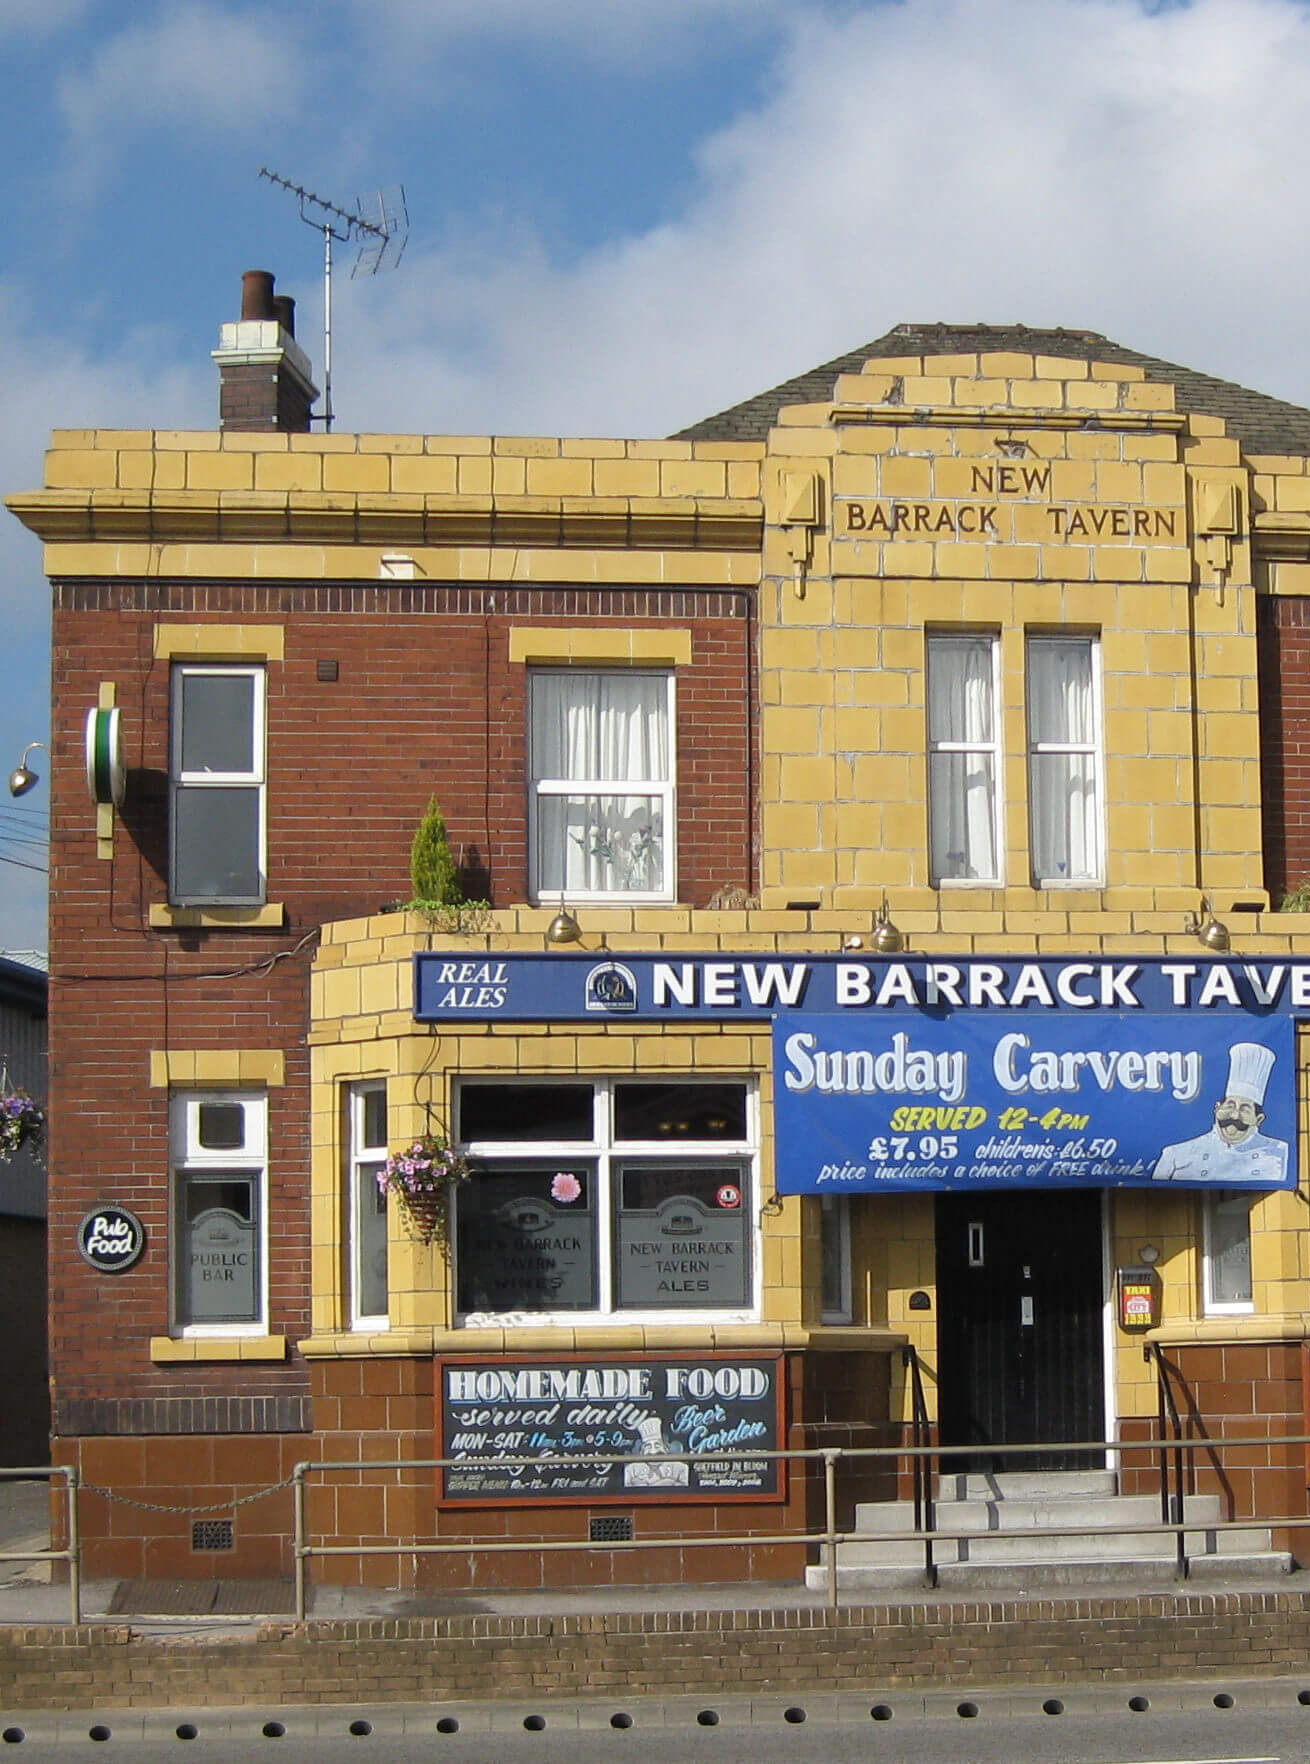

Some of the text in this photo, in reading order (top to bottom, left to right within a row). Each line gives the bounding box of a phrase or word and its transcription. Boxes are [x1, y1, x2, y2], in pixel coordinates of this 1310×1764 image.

[971, 466, 1050, 493] NEW
[846, 503, 1176, 537] BARRACK TAVERN
[438, 963, 508, 984] REAL
[653, 964, 807, 1005] NEW
[837, 964, 1138, 1006] BARRACK
[438, 987, 507, 1008] ALES
[784, 1032, 1201, 1102] Sunday Carvery
[890, 1107, 987, 1131] SERVED
[868, 1136, 958, 1160] £7.95
[816, 1160, 866, 1184] price
[874, 1161, 947, 1178] includes
[954, 1166, 966, 1178] a
[969, 1160, 1023, 1178] choice
[1026, 1161, 1048, 1177] of
[1049, 1162, 1089, 1177] FREE
[93, 1217, 129, 1236] Pub
[87, 1231, 133, 1255] Food
[514, 1237, 582, 1250] BARRACK
[630, 1242, 735, 1255] NEW BARRACK
[191, 1253, 248, 1267] PUBLIC
[501, 1259, 556, 1270] TAVERN
[655, 1261, 710, 1273] TAVERN
[202, 1268, 235, 1282] BAR
[656, 1280, 710, 1292] ALES
[448, 1367, 769, 1402] HOMEMADE FOOD
[452, 1402, 652, 1430] served daily
[671, 1404, 726, 1432] Beer
[689, 1419, 767, 1454] Garden
